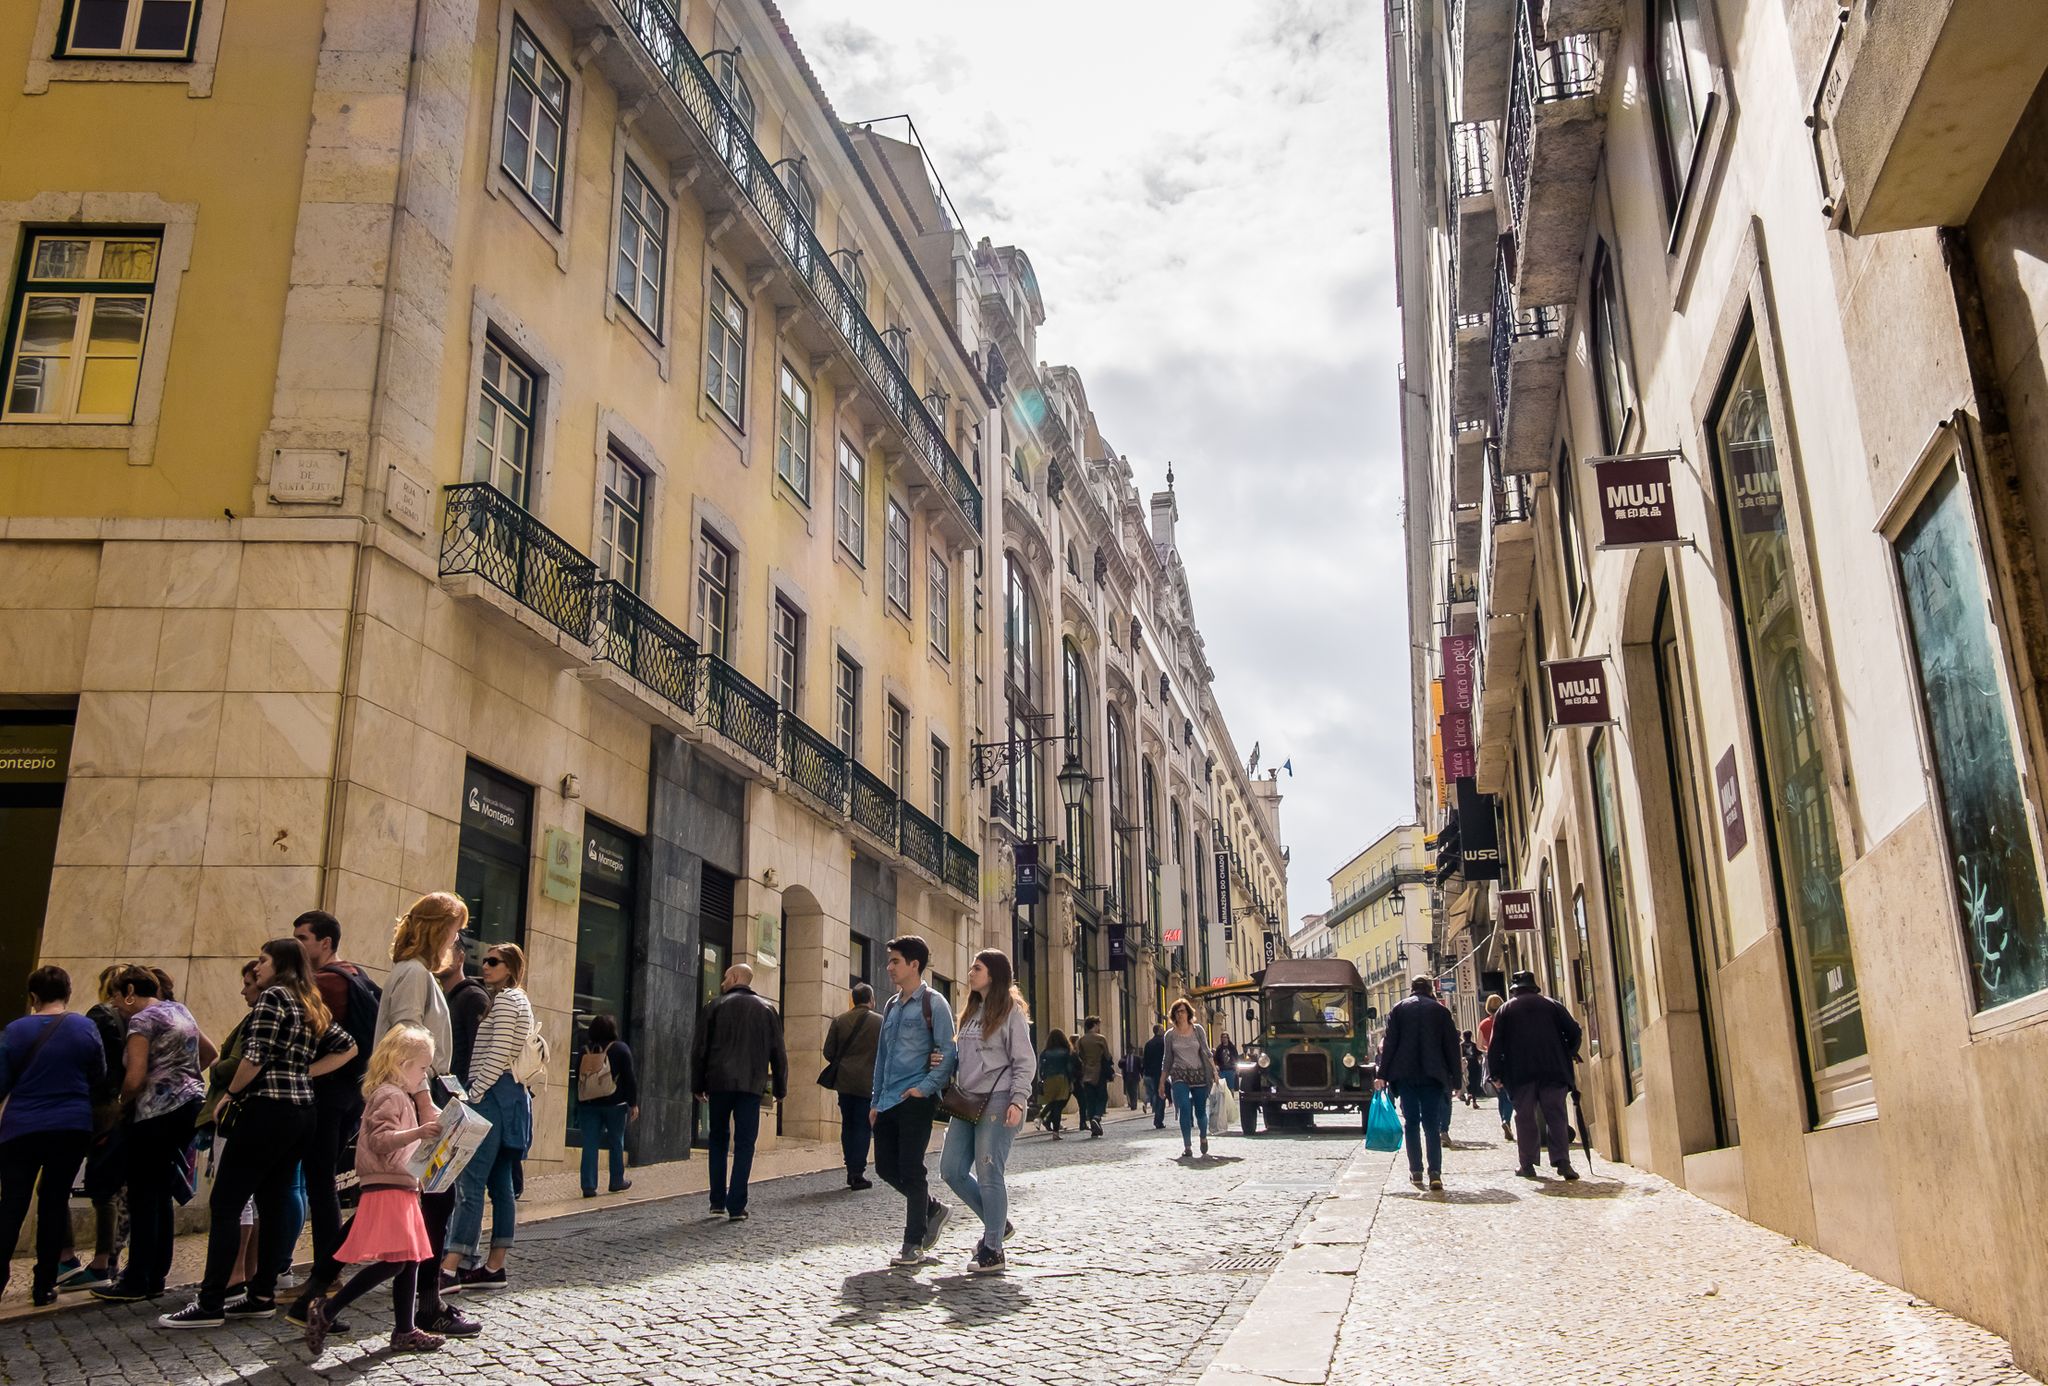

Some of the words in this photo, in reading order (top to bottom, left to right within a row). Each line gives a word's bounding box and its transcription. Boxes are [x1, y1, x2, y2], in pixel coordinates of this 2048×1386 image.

[1826, 69, 1842, 110] RUA
[300, 471, 314, 480] DE
[403, 482, 416, 497] RUA
[1606, 482, 1666, 509] MUJI
[403, 494, 413, 506] DO
[395, 502, 419, 522] CARMO
[1614, 506, 1662, 520] 無印良品
[1557, 677, 1601, 699] MUJI
[0, 756, 56, 770] ontepio
[481, 803, 515, 826] Montepio
[598, 852, 624, 872] Montepio
[1505, 902, 1530, 915] MUJI
[1265, 941, 1274, 964] NGO
